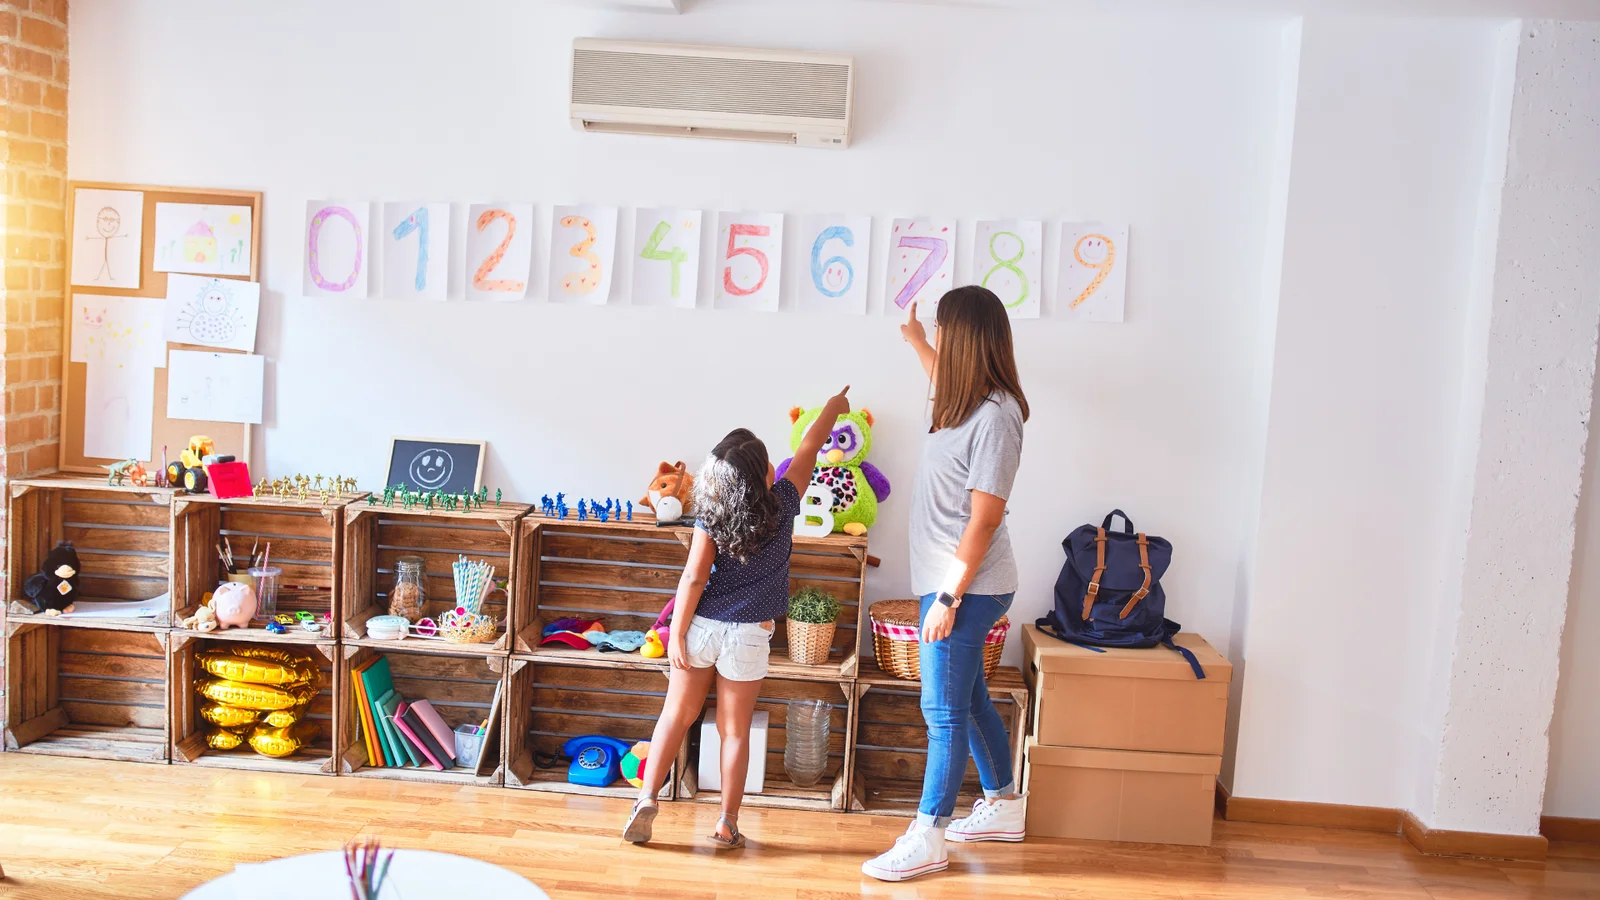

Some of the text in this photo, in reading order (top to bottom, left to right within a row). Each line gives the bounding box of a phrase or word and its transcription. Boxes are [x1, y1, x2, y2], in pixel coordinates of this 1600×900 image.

[308, 206, 1116, 310] 0 1 2 3 4 5 6 7 8 9
[794, 485, 835, 538] B
